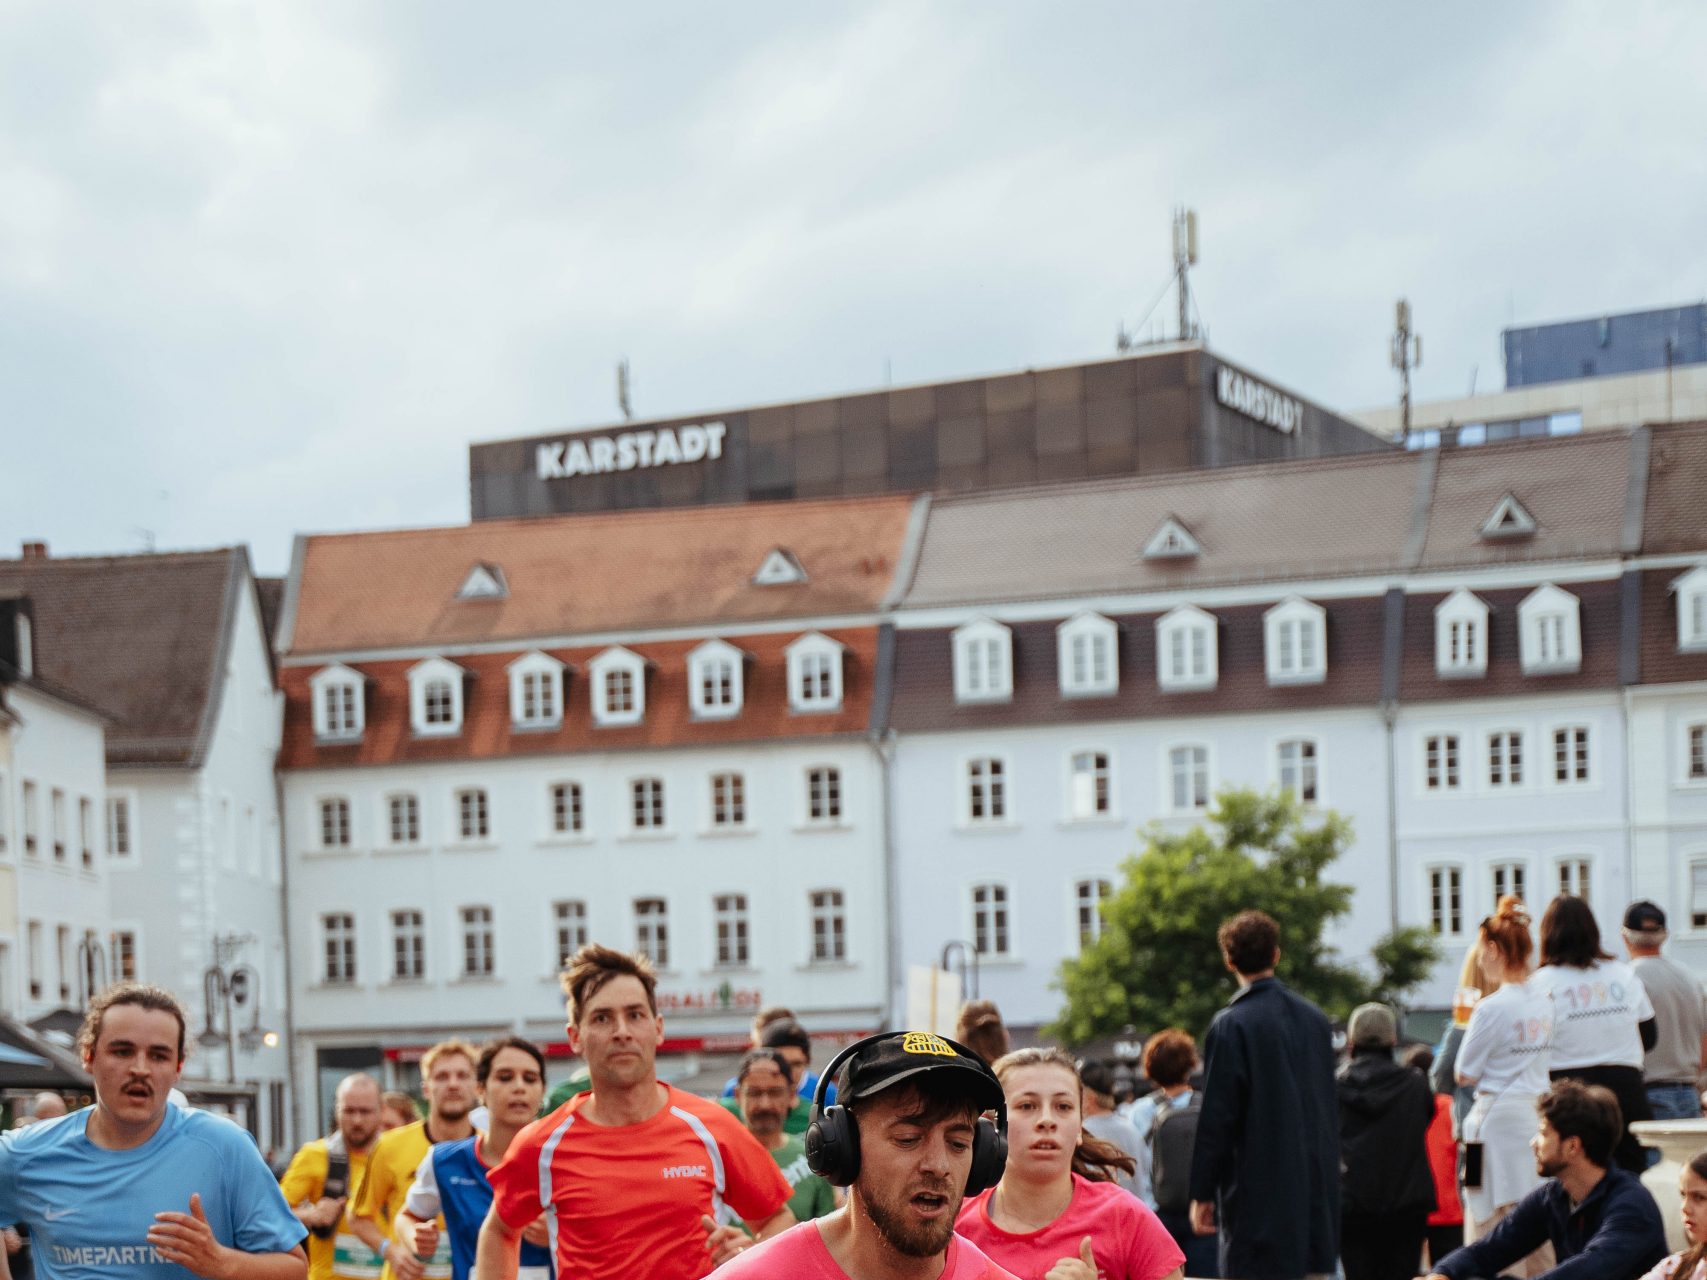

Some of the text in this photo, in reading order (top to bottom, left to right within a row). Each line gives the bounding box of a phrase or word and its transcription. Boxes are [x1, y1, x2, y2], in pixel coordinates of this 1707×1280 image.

[1217, 365, 1304, 436] KARSTADT
[536, 421, 727, 481] KARSTADT
[663, 1165, 706, 1178] HYDAC
